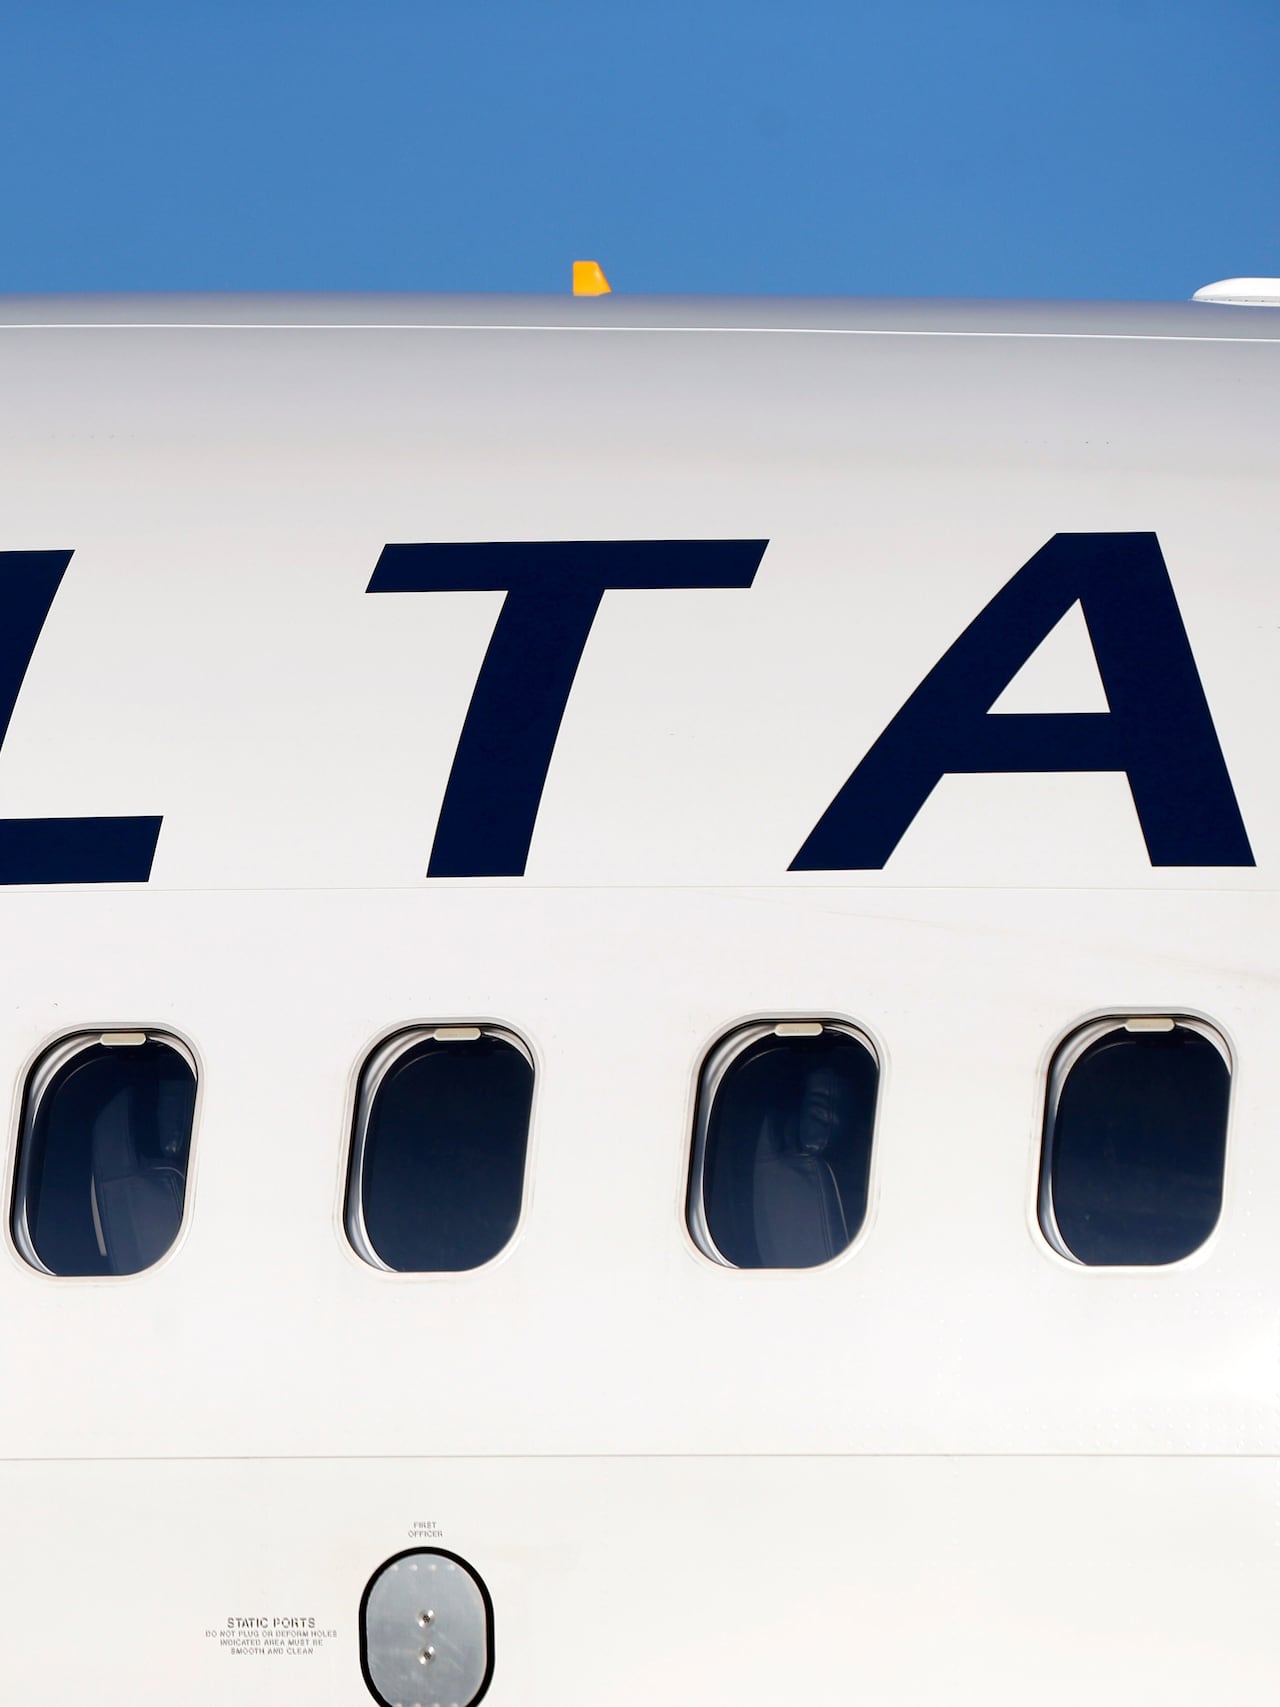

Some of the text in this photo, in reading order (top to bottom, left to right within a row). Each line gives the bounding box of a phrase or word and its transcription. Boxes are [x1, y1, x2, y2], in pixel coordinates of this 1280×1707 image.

[413, 1521, 437, 1529] FIRST
[408, 1530, 443, 1538] OFFICER
[227, 1617, 316, 1629] STATIC PORTS
[205, 1630, 337, 1638] DO NOT PLUG OR DEFORM HOLES
[231, 1647, 314, 1655] SMOOTH AND CLEAN
